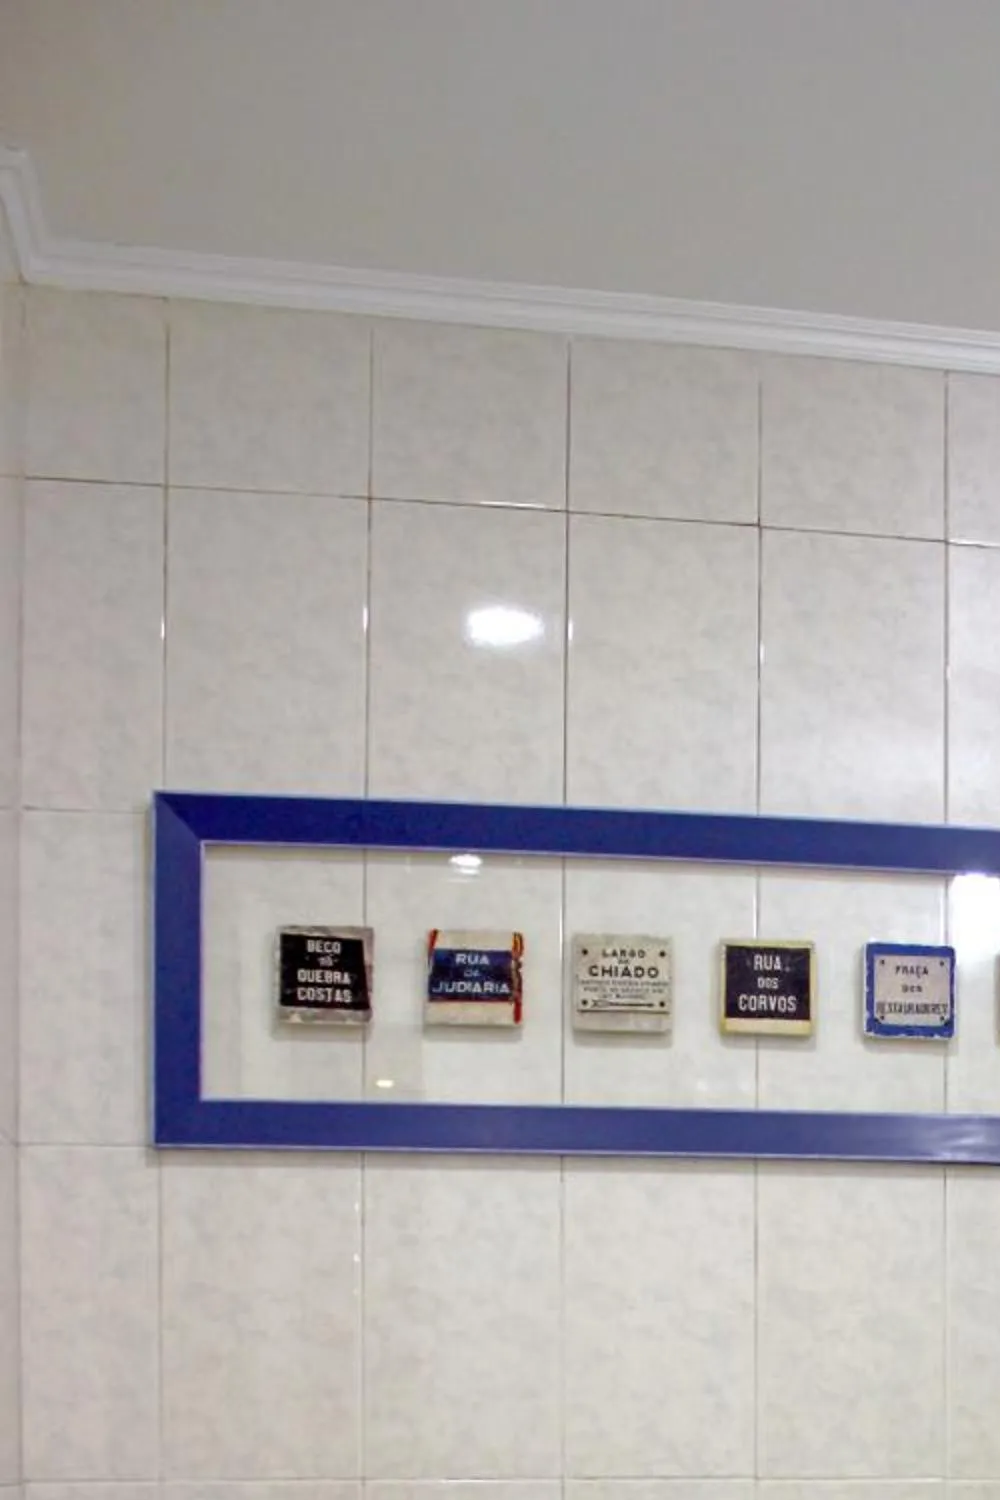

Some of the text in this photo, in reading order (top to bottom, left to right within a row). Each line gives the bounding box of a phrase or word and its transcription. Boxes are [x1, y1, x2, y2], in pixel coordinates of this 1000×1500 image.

[307, 940, 341, 954] BECO
[602, 949, 646, 958] LARGO
[455, 954, 490, 965] RUA
[754, 954, 782, 971] RUA
[588, 965, 659, 979] CHIADO
[432, 981, 510, 993] JUDIARIA
[757, 977, 779, 989] DOS
[297, 987, 352, 1003] COSTAS
[738, 994, 798, 1013] CORVOS
